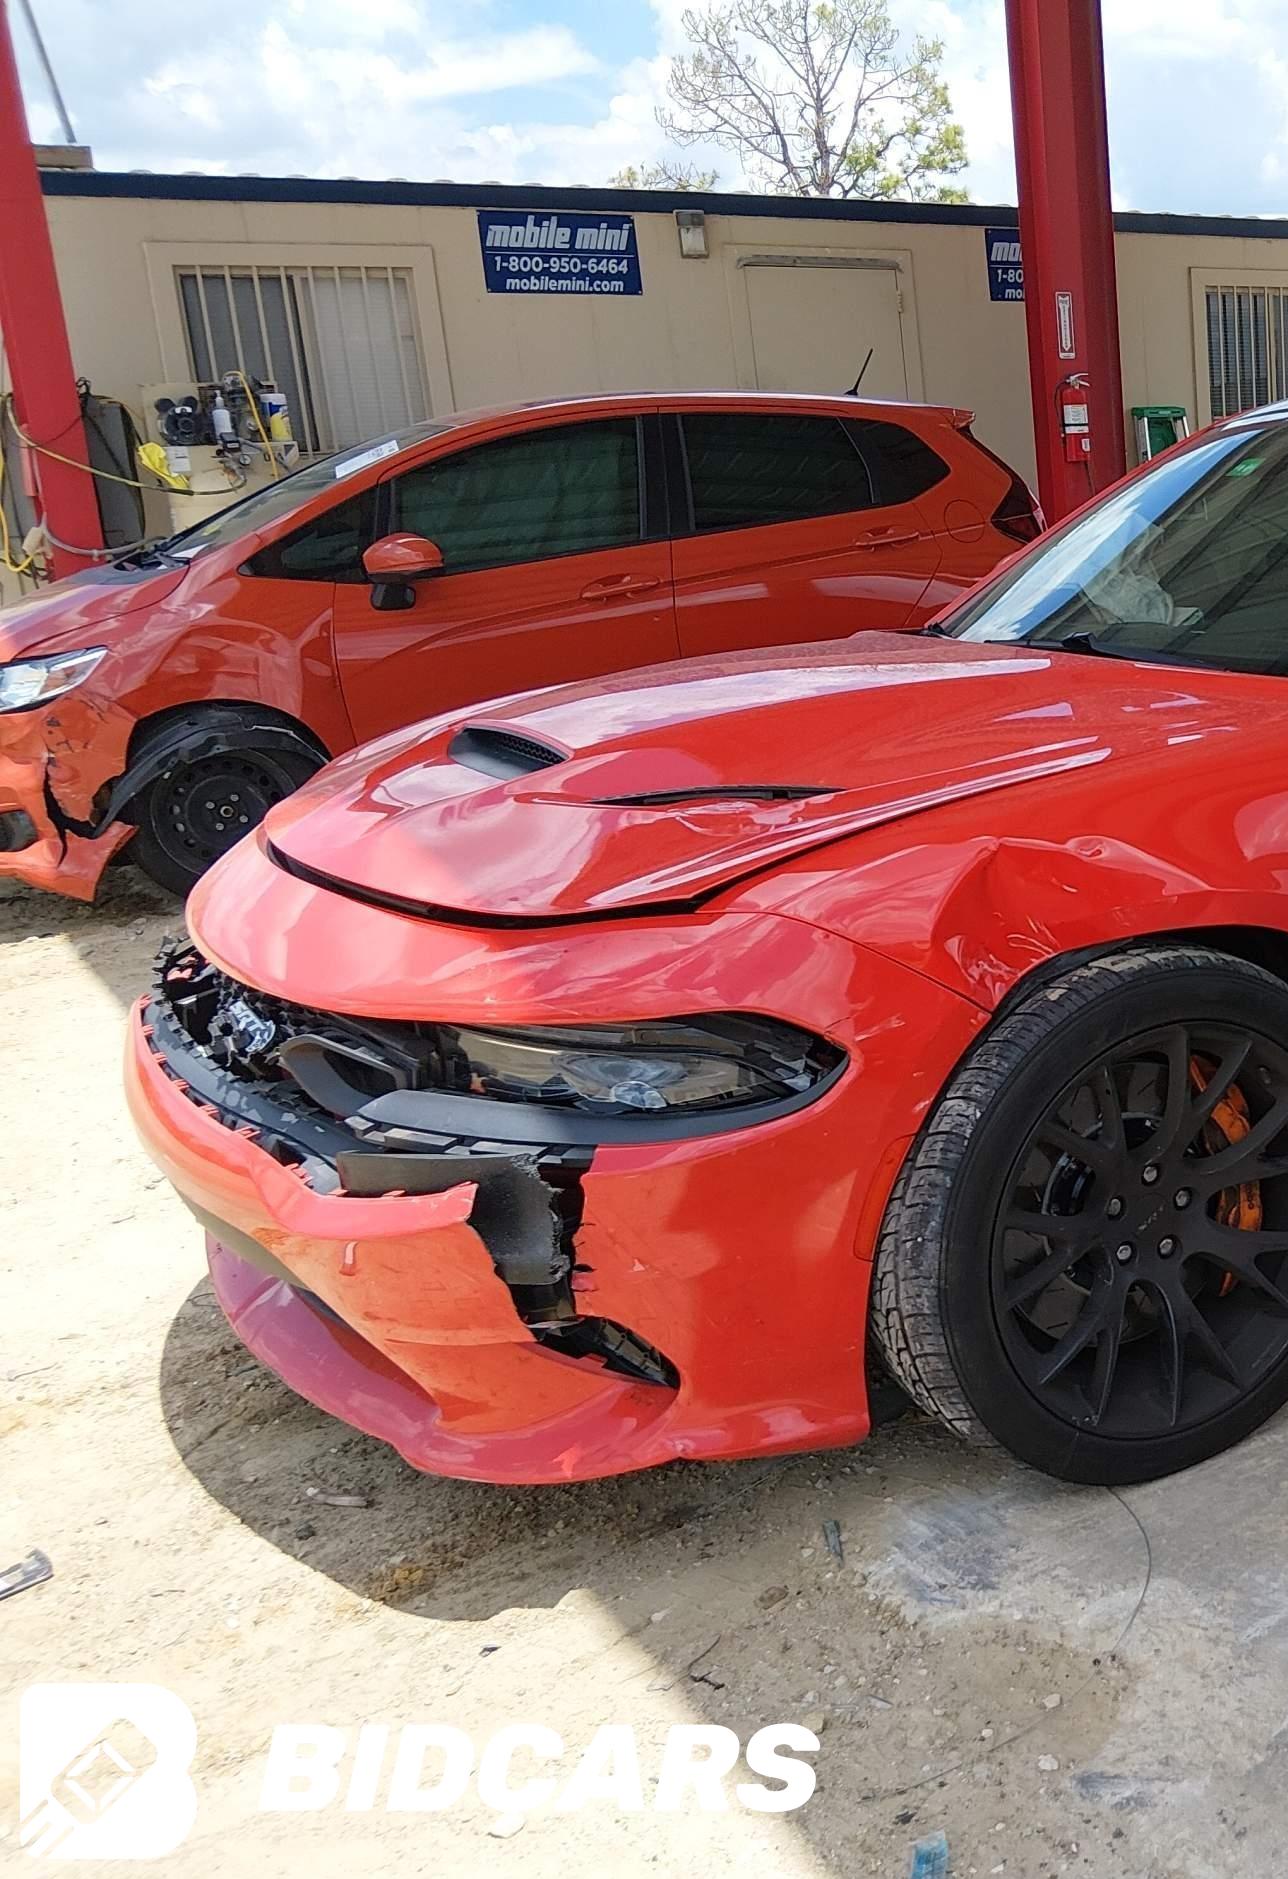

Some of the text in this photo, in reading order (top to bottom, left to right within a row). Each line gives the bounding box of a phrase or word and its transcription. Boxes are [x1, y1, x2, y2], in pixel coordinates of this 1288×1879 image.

[486, 215, 631, 250] mobile mini
[494, 256, 629, 274] 1-800-950-6464
[505, 275, 624, 292] mobilemini.com
